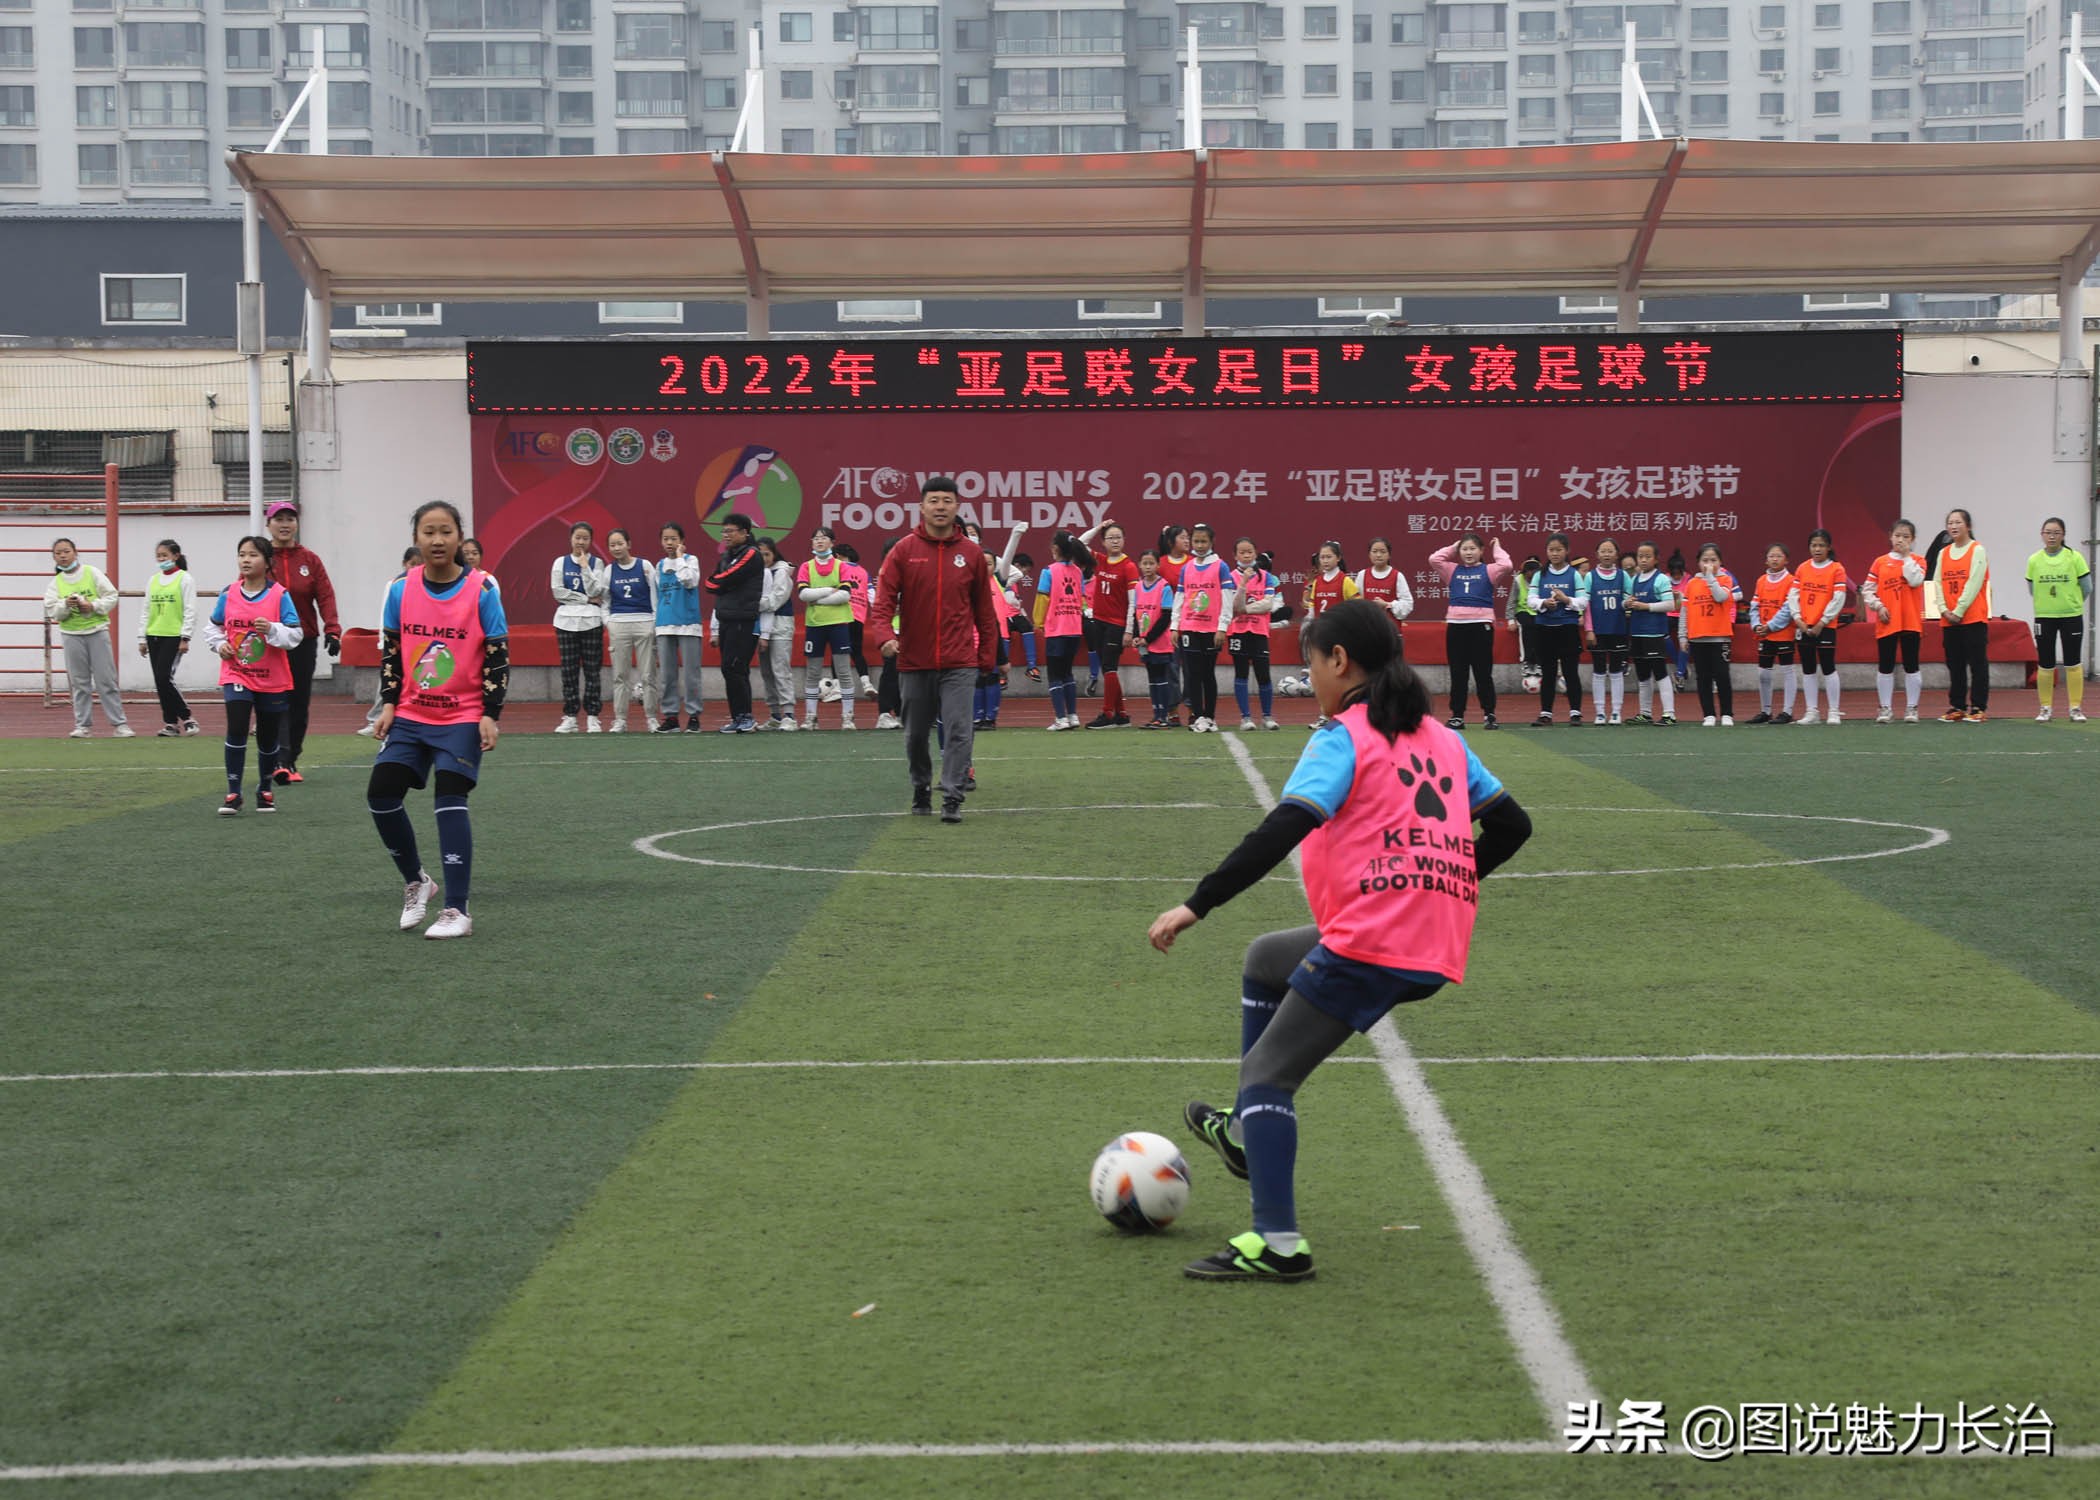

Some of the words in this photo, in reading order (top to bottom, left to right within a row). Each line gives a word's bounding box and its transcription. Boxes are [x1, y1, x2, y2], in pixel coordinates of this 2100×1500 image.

[659, 349, 877, 397] 2022年
[917, 343, 1366, 397] “亚足联女足日”
[1405, 341, 1712, 393] 女孩足球节
[1142, 469, 1269, 503] 2022年
[1287, 467, 1541, 502] “亚足联女足日”
[1559, 464, 1742, 500] 女孩足球节
[821, 500, 1026, 530] FOOTALL
[1030, 499, 1113, 529] DAY
[1407, 511, 1739, 534] 暨2022年长治足球进校园系列活动
[572, 577, 581, 590] 9
[1463, 581, 1470, 594] 1
[623, 585, 633, 599] 2
[2049, 585, 2057, 599] 4
[1320, 599, 1329, 613] 2
[1602, 596, 1617, 610] 10
[1701, 603, 1715, 617] 12
[227, 619, 255, 628] KELM
[403, 622, 455, 640] KELME
[1383, 828, 1475, 859] KELME
[1360, 873, 1460, 898] FOOTBALL
[1462, 886, 1477, 907] DA
